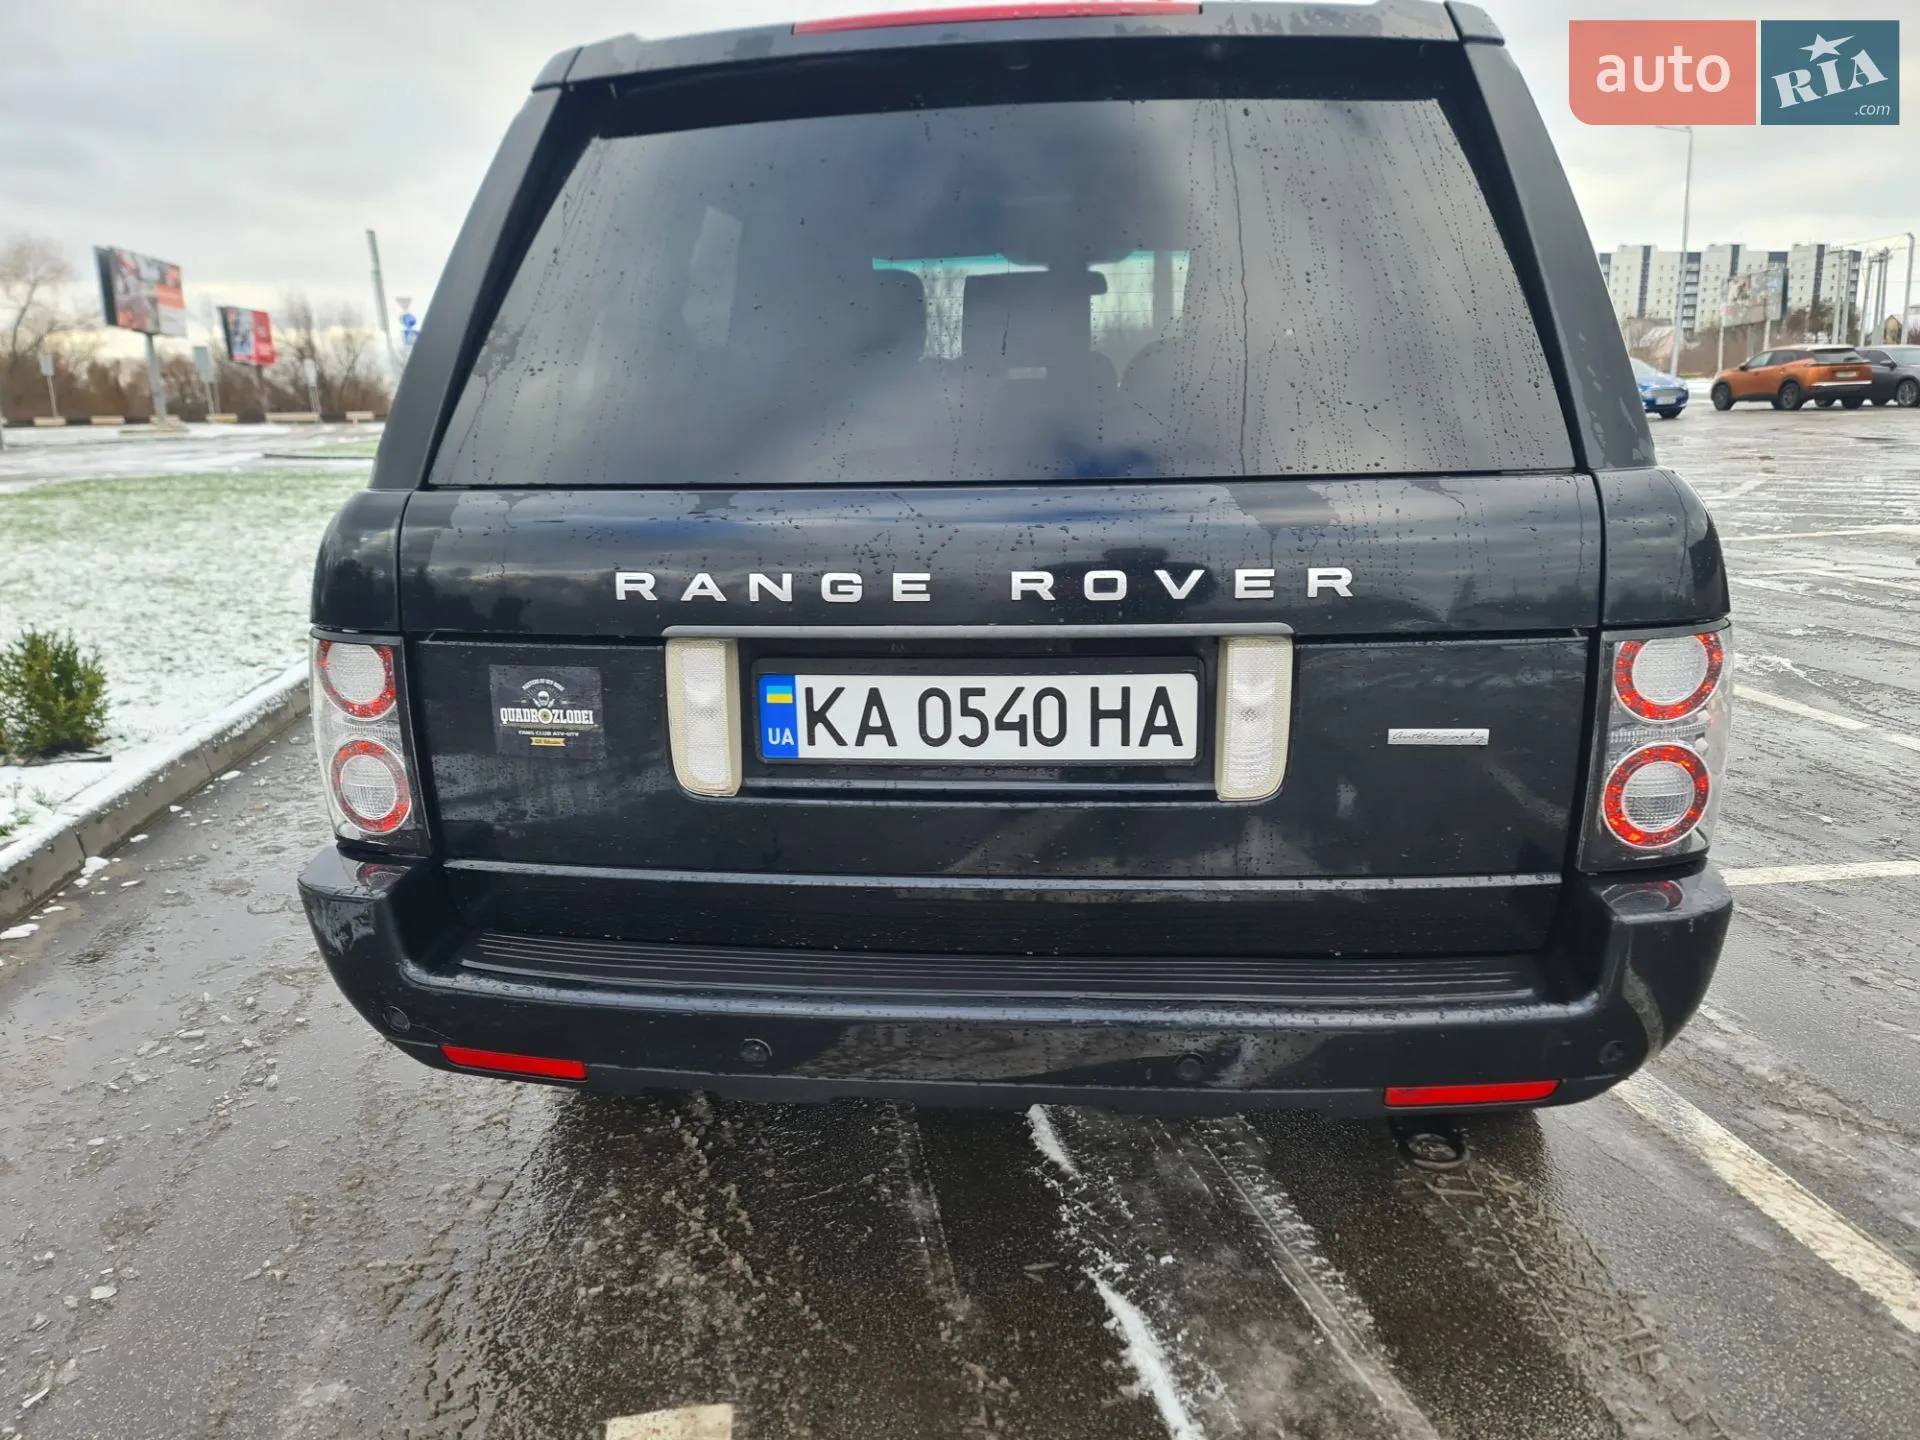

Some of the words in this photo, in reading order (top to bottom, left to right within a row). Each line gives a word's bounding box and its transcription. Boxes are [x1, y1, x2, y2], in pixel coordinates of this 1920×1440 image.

[614, 571, 932, 603] RANGE
[1010, 566, 1355, 601] ROVER
[805, 686, 898, 747] KA
[917, 686, 1068, 747] 0540
[1089, 686, 1184, 747] HA
[768, 727, 795, 746] UA
